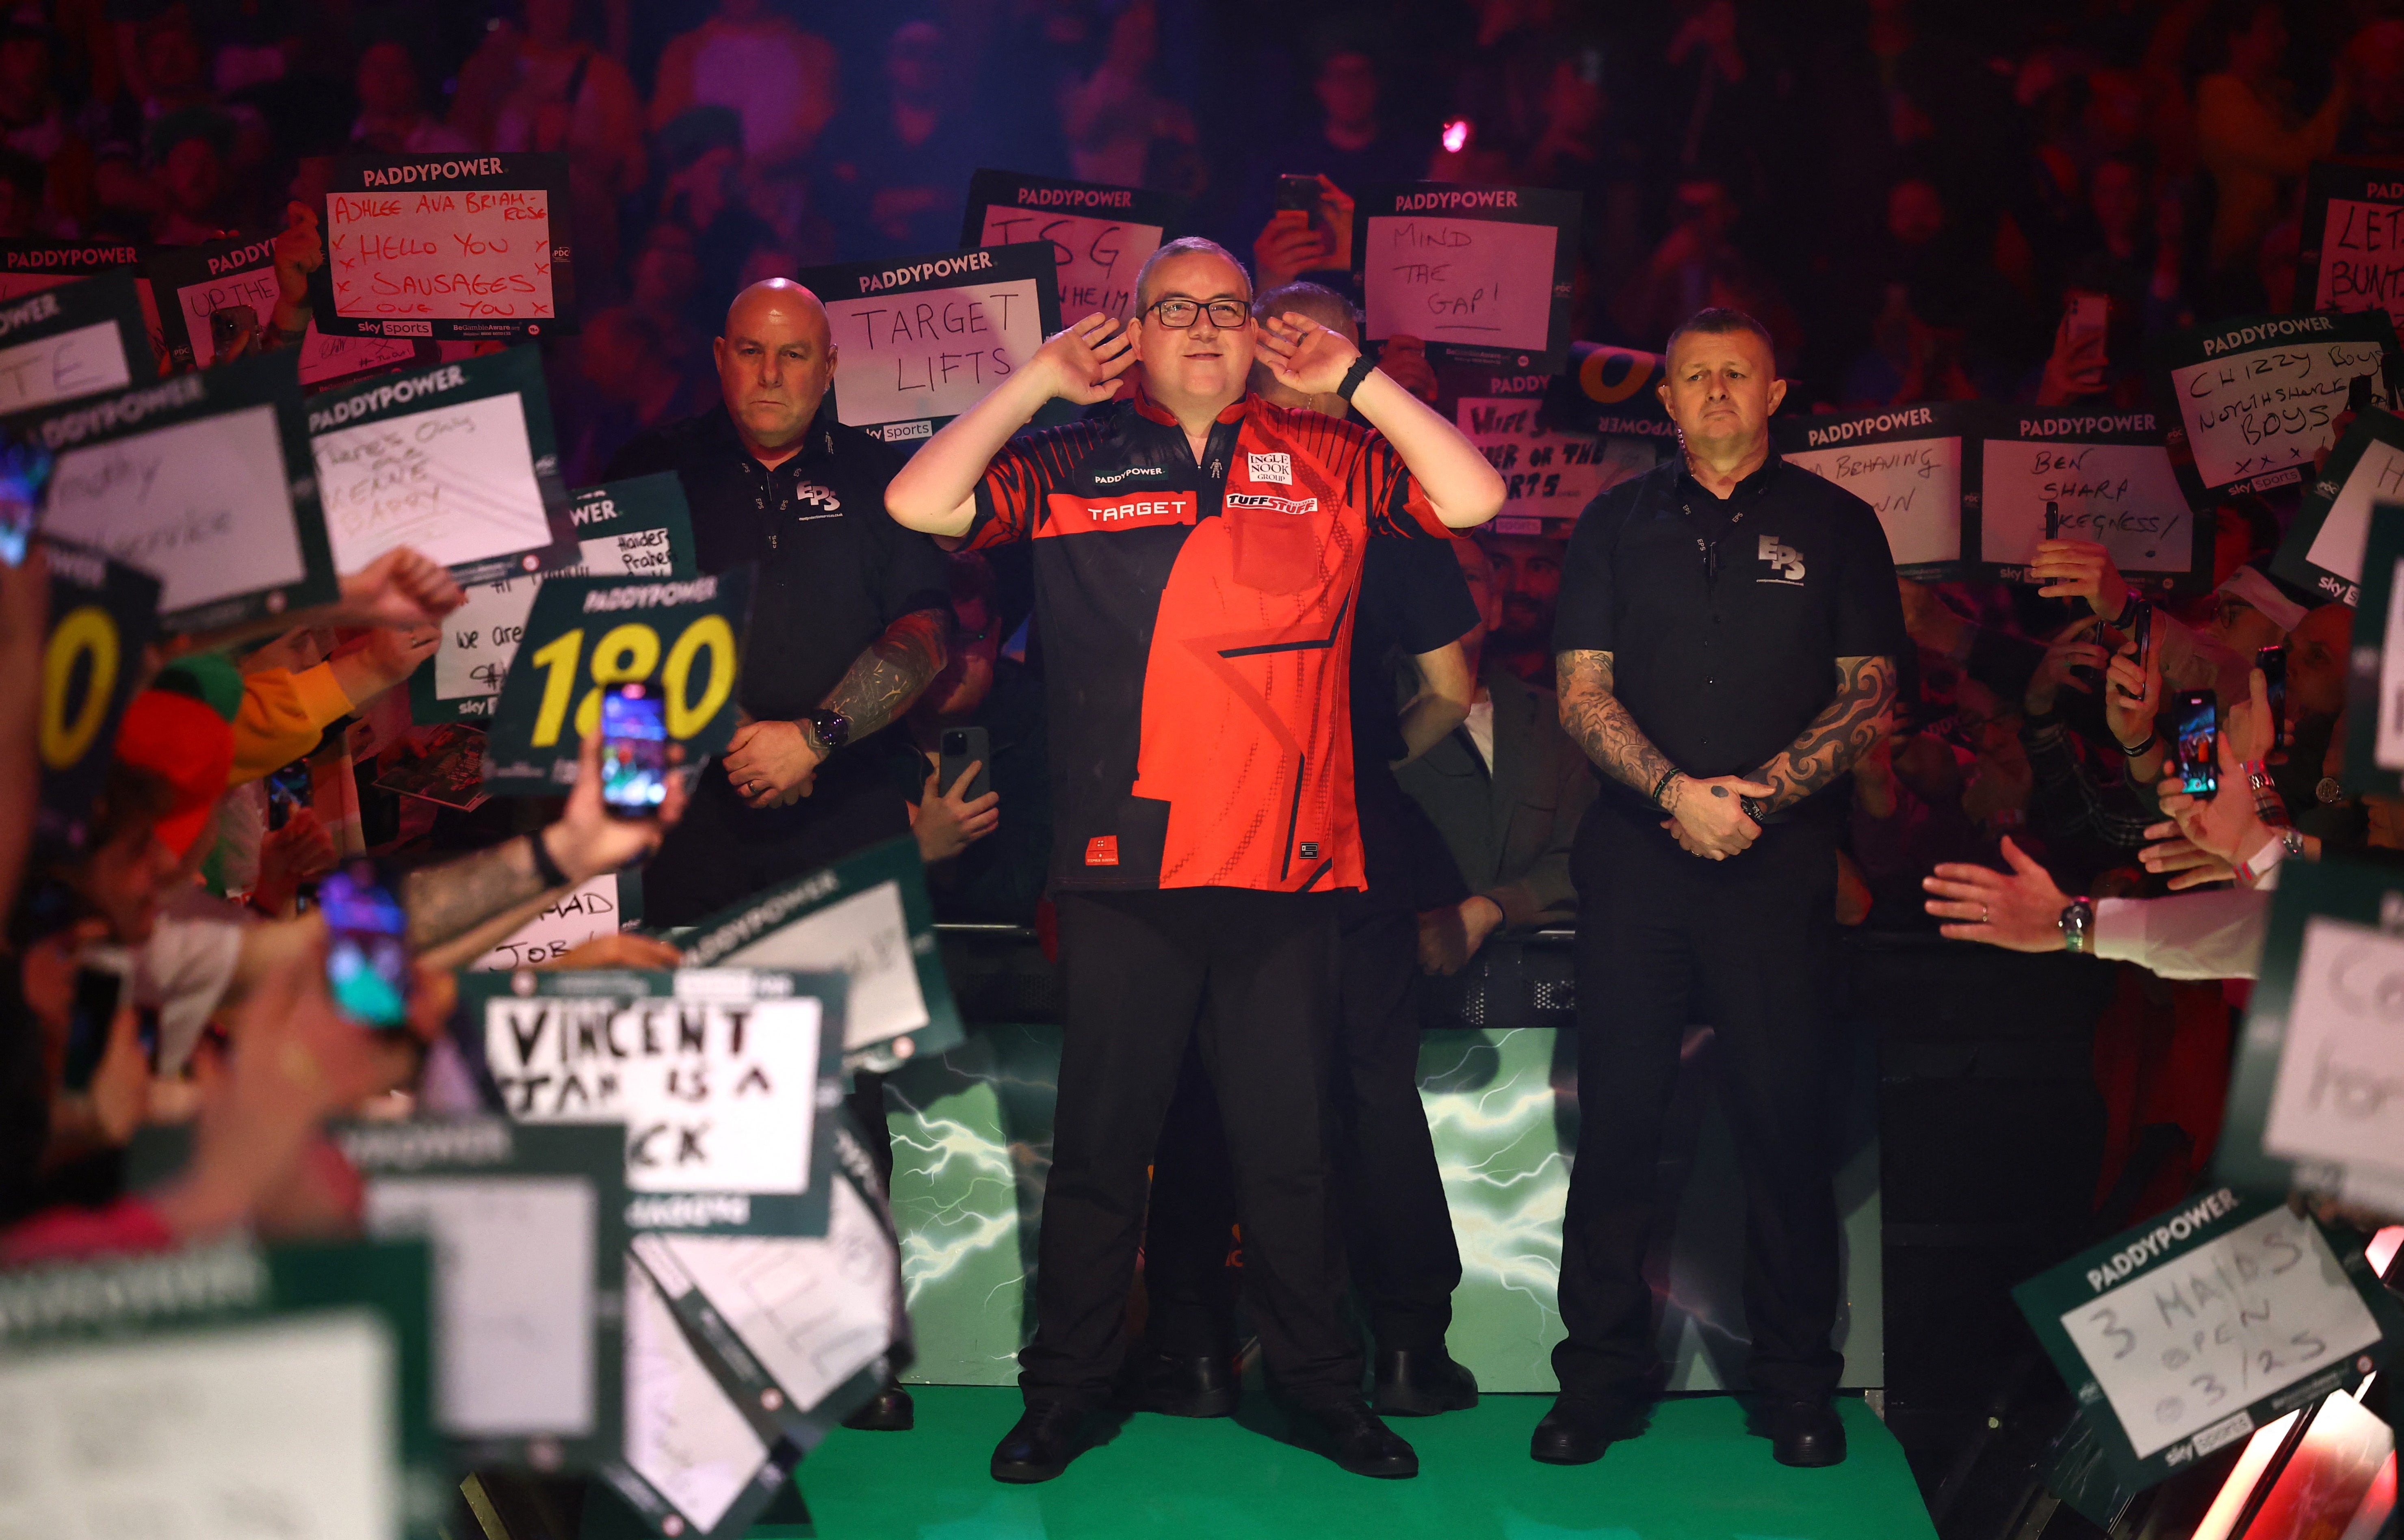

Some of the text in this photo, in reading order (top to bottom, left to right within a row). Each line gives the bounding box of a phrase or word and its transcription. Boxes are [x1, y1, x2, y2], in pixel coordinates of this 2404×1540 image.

[364, 158, 503, 187] PADDYPOWER
[416, 195, 455, 214] AVA
[1018, 188, 1131, 207] PADDYPOWER
[1395, 191, 1518, 212] PADDYPOWER
[1394, 223, 1472, 247] MIND
[7, 247, 138, 268] PADDYPOWER
[360, 234, 437, 265] HELLO
[453, 233, 508, 257] YOU
[858, 251, 993, 293] PADDYPOWER
[1393, 263, 1451, 284] THE
[372, 272, 536, 296] SAUSAGES
[191, 278, 275, 318] UP THE
[459, 301, 514, 317] YOU
[358, 322, 429, 333] sky sports
[851, 294, 1019, 350] TARGET
[2203, 317, 2333, 356] PADDYPOWER
[898, 348, 1011, 391] LIFTS
[2190, 353, 2311, 398] CHIZZY
[308, 365, 468, 433] PADDYPOWER
[886, 422, 929, 438] sports
[1808, 407, 1932, 447] PADDYPOWER
[2020, 414, 2157, 437] PADDYPOWER
[742, 462, 750, 473] EPS
[1250, 454, 1289, 465] INGLE
[1251, 464, 1289, 475] NOOK
[1837, 448, 1941, 479] BEHAVING
[2031, 448, 2095, 475] BEN
[793, 468, 802, 477] EPS
[1095, 467, 1163, 484] PADDYPOWER
[1257, 474, 1285, 482] GROUP
[2228, 470, 2298, 496] sky sports
[796, 480, 840, 511] EPS
[2038, 479, 2128, 502] SHARP
[756, 497, 764, 510] EPS
[780, 500, 788, 510] EPS
[1087, 501, 1186, 521] TARGET
[1682, 504, 1691, 515] EPS
[1732, 512, 1743, 523] EPS
[1697, 538, 1706, 552] EPS
[1758, 534, 1806, 580] EPS
[2000, 568, 2022, 581] sky
[583, 576, 719, 614] PADDYPOWER
[2318, 575, 2346, 599] sky
[530, 614, 737, 748] 180
[458, 701, 485, 716] sky
[508, 1005, 752, 1065] VINCENT
[734, 1063, 773, 1097] A
[2086, 1188, 2239, 1292] PADDYPOWER
[2089, 1233, 2303, 1360] 3 MAIDS
